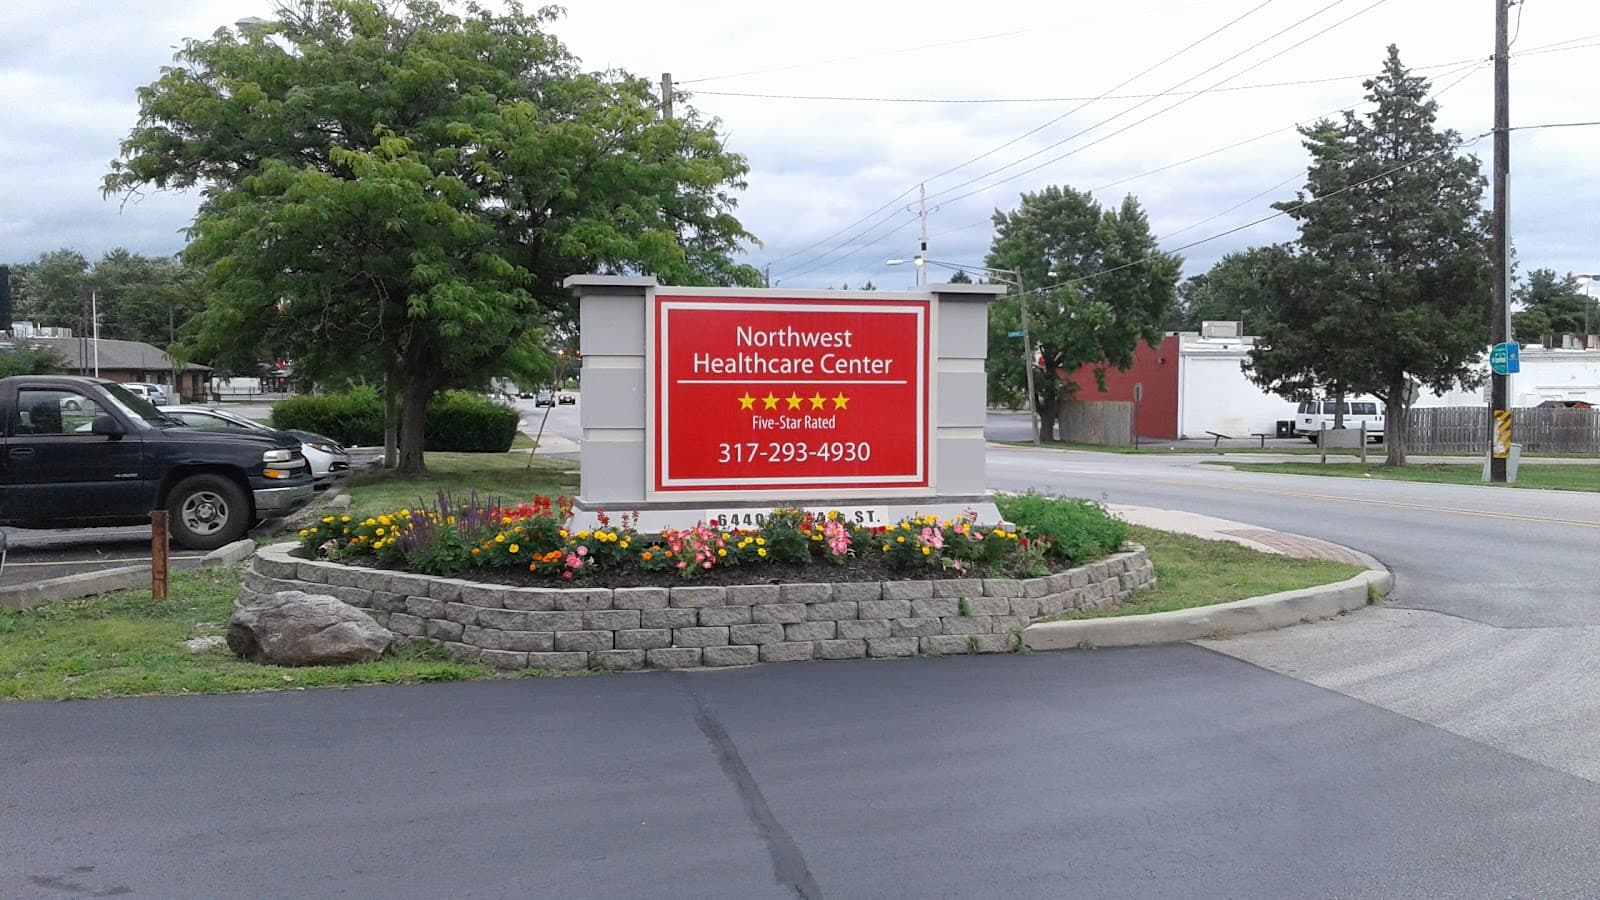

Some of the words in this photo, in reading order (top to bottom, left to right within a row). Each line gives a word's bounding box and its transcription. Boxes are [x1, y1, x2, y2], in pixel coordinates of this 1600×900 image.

[736, 326, 852, 347] Northwest
[693, 352, 814, 374] Healthcare
[820, 354, 893, 374] Center
[752, 415, 801, 430] Five-Star
[804, 415, 836, 430] Rated
[718, 442, 871, 463] 317-293-4930
[717, 513, 764, 526] 6440
[855, 510, 881, 523] ST.
